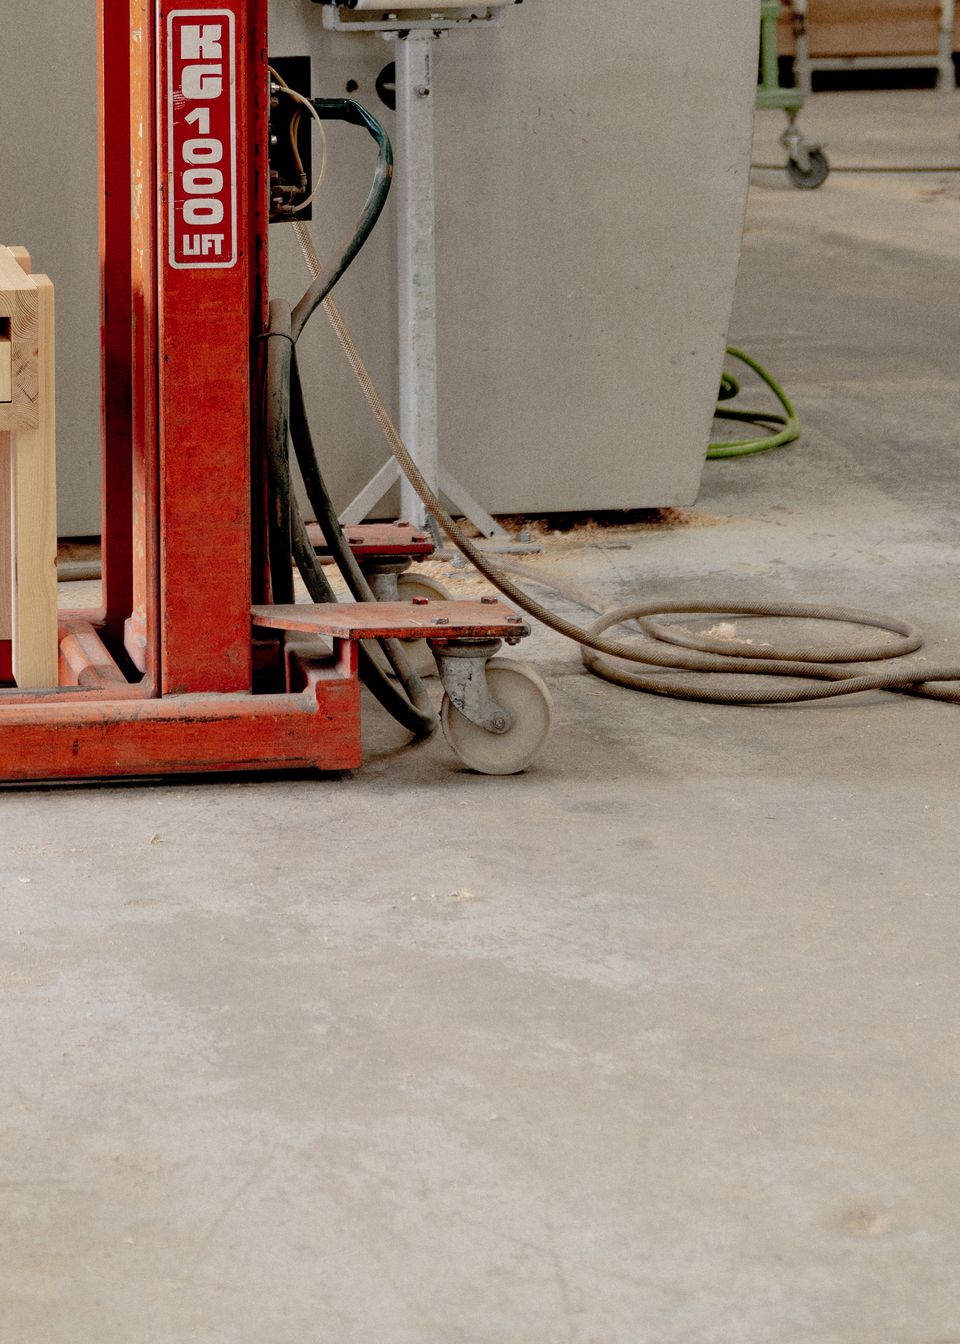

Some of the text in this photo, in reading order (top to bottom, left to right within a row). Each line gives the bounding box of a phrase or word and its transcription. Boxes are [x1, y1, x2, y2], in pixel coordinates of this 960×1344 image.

[180, 24, 224, 225] KG 1000
[182, 233, 225, 256] LIFT
